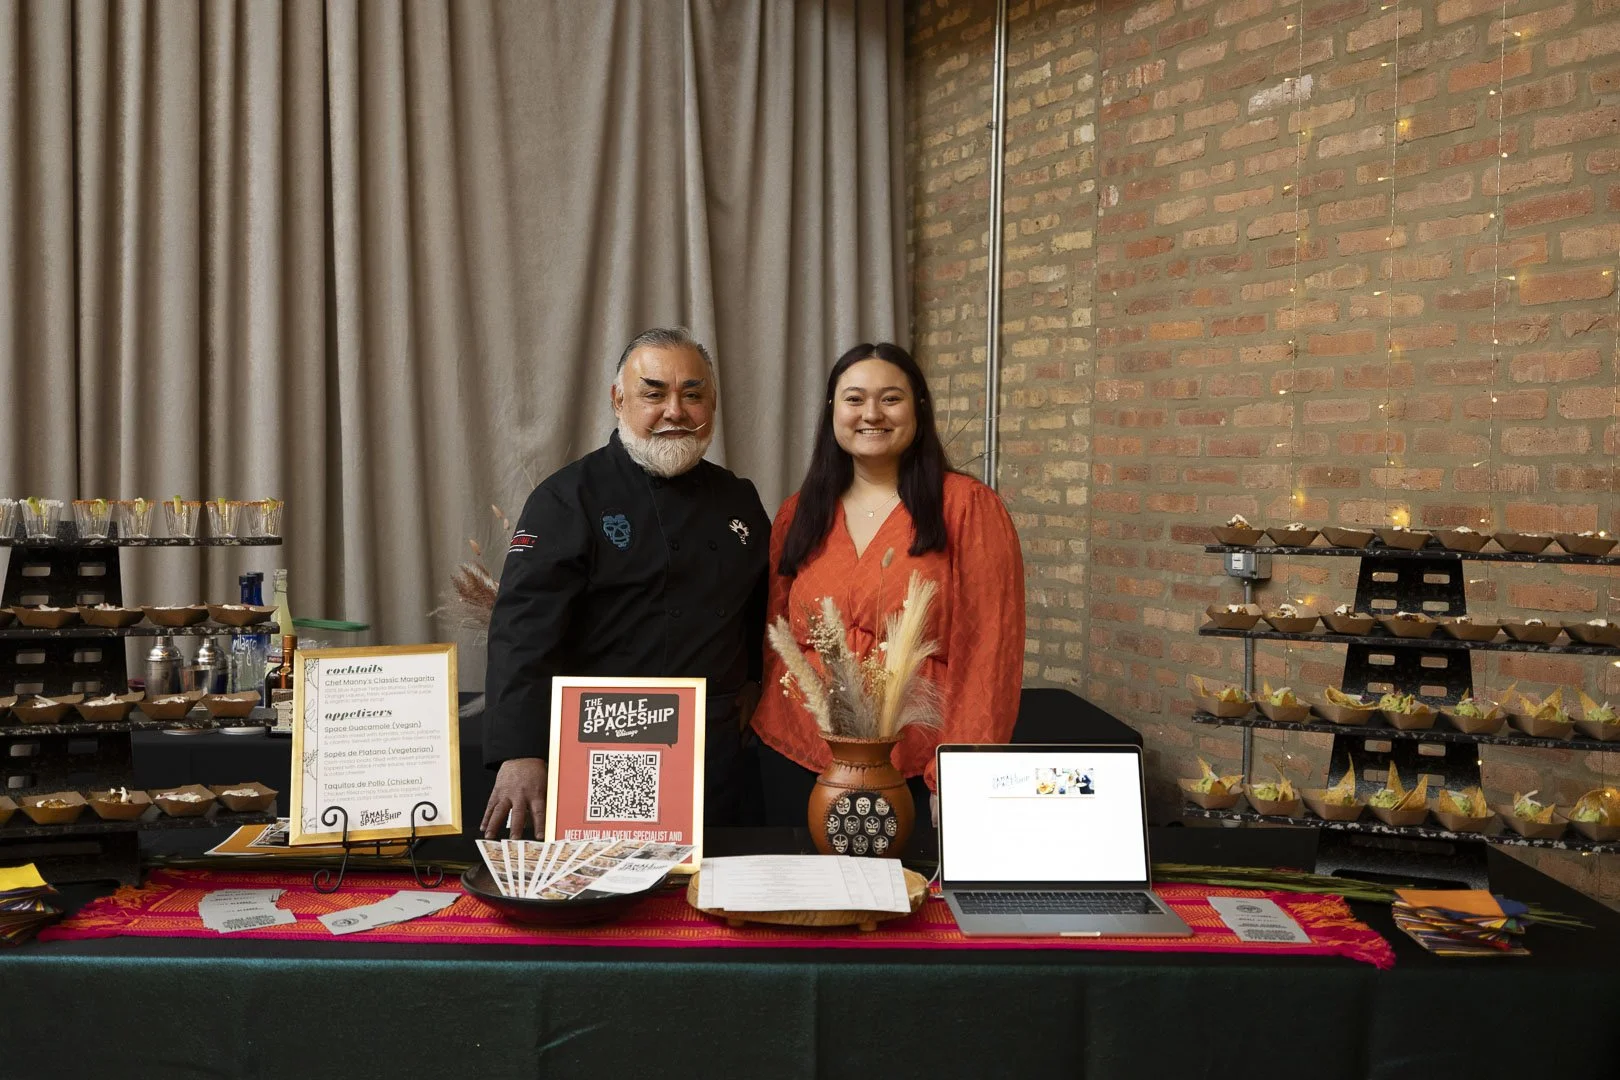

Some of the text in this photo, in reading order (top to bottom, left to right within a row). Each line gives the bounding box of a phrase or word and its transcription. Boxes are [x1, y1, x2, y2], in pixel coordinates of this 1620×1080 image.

[326, 664, 383, 675] cocktails
[324, 675, 435, 687] Chef Manny's Classic Margarita
[584, 697, 603, 708] THE
[324, 708, 393, 721] appetizers
[584, 698, 648, 721] TAMALE
[324, 720, 422, 734] Space Guacamole (Vegan)
[583, 707, 675, 734] SPACESHIP
[614, 728, 639, 738] Chicago
[388, 745, 434, 755] (Vegetarian)
[323, 781, 355, 791] Taquitos
[387, 777, 423, 787] (Chicken)
[360, 808, 390, 821] TAMALE
[360, 811, 402, 827] SPACESHIP
[564, 829, 683, 842] MEET WITH AN EVENT SPECIALIST AND
